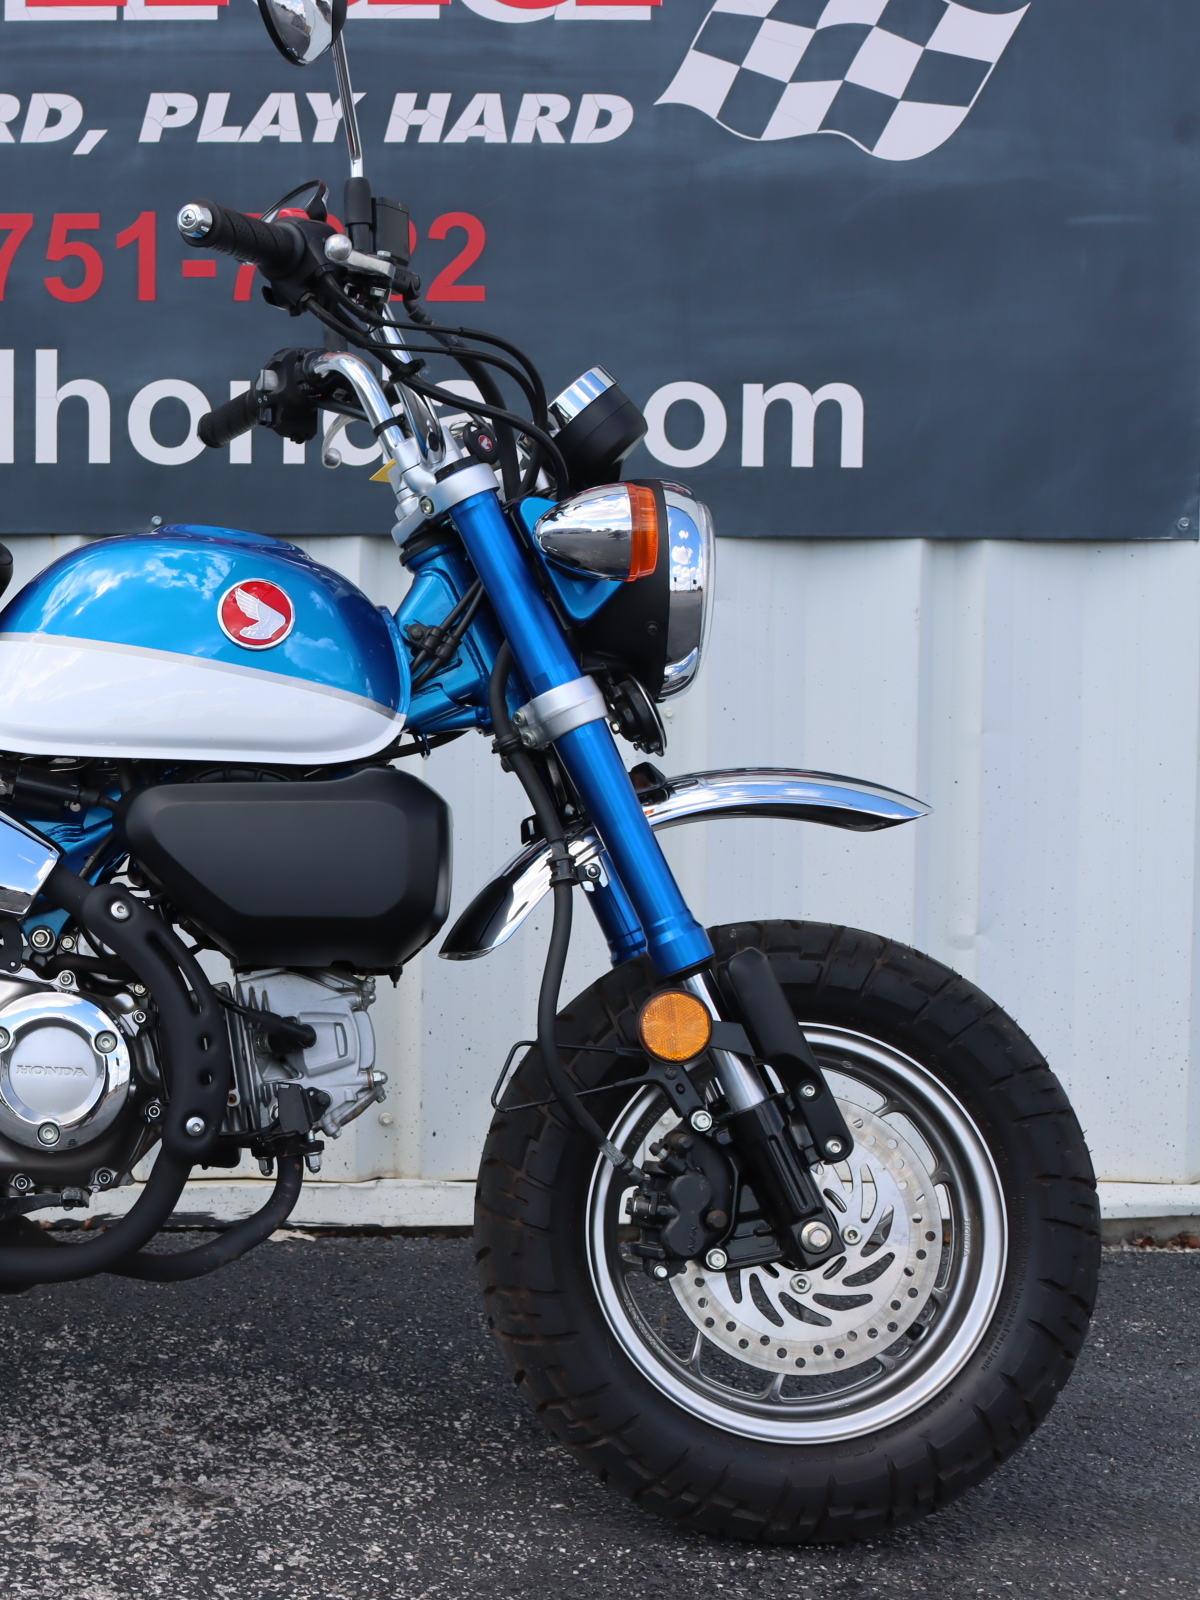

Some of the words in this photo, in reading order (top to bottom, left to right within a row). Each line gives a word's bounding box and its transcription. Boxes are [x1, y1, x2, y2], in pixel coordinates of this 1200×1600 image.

[138, 92, 367, 147] PLAY
[385, 92, 634, 145] HARD
[16, 1064, 88, 1077] HONDA
